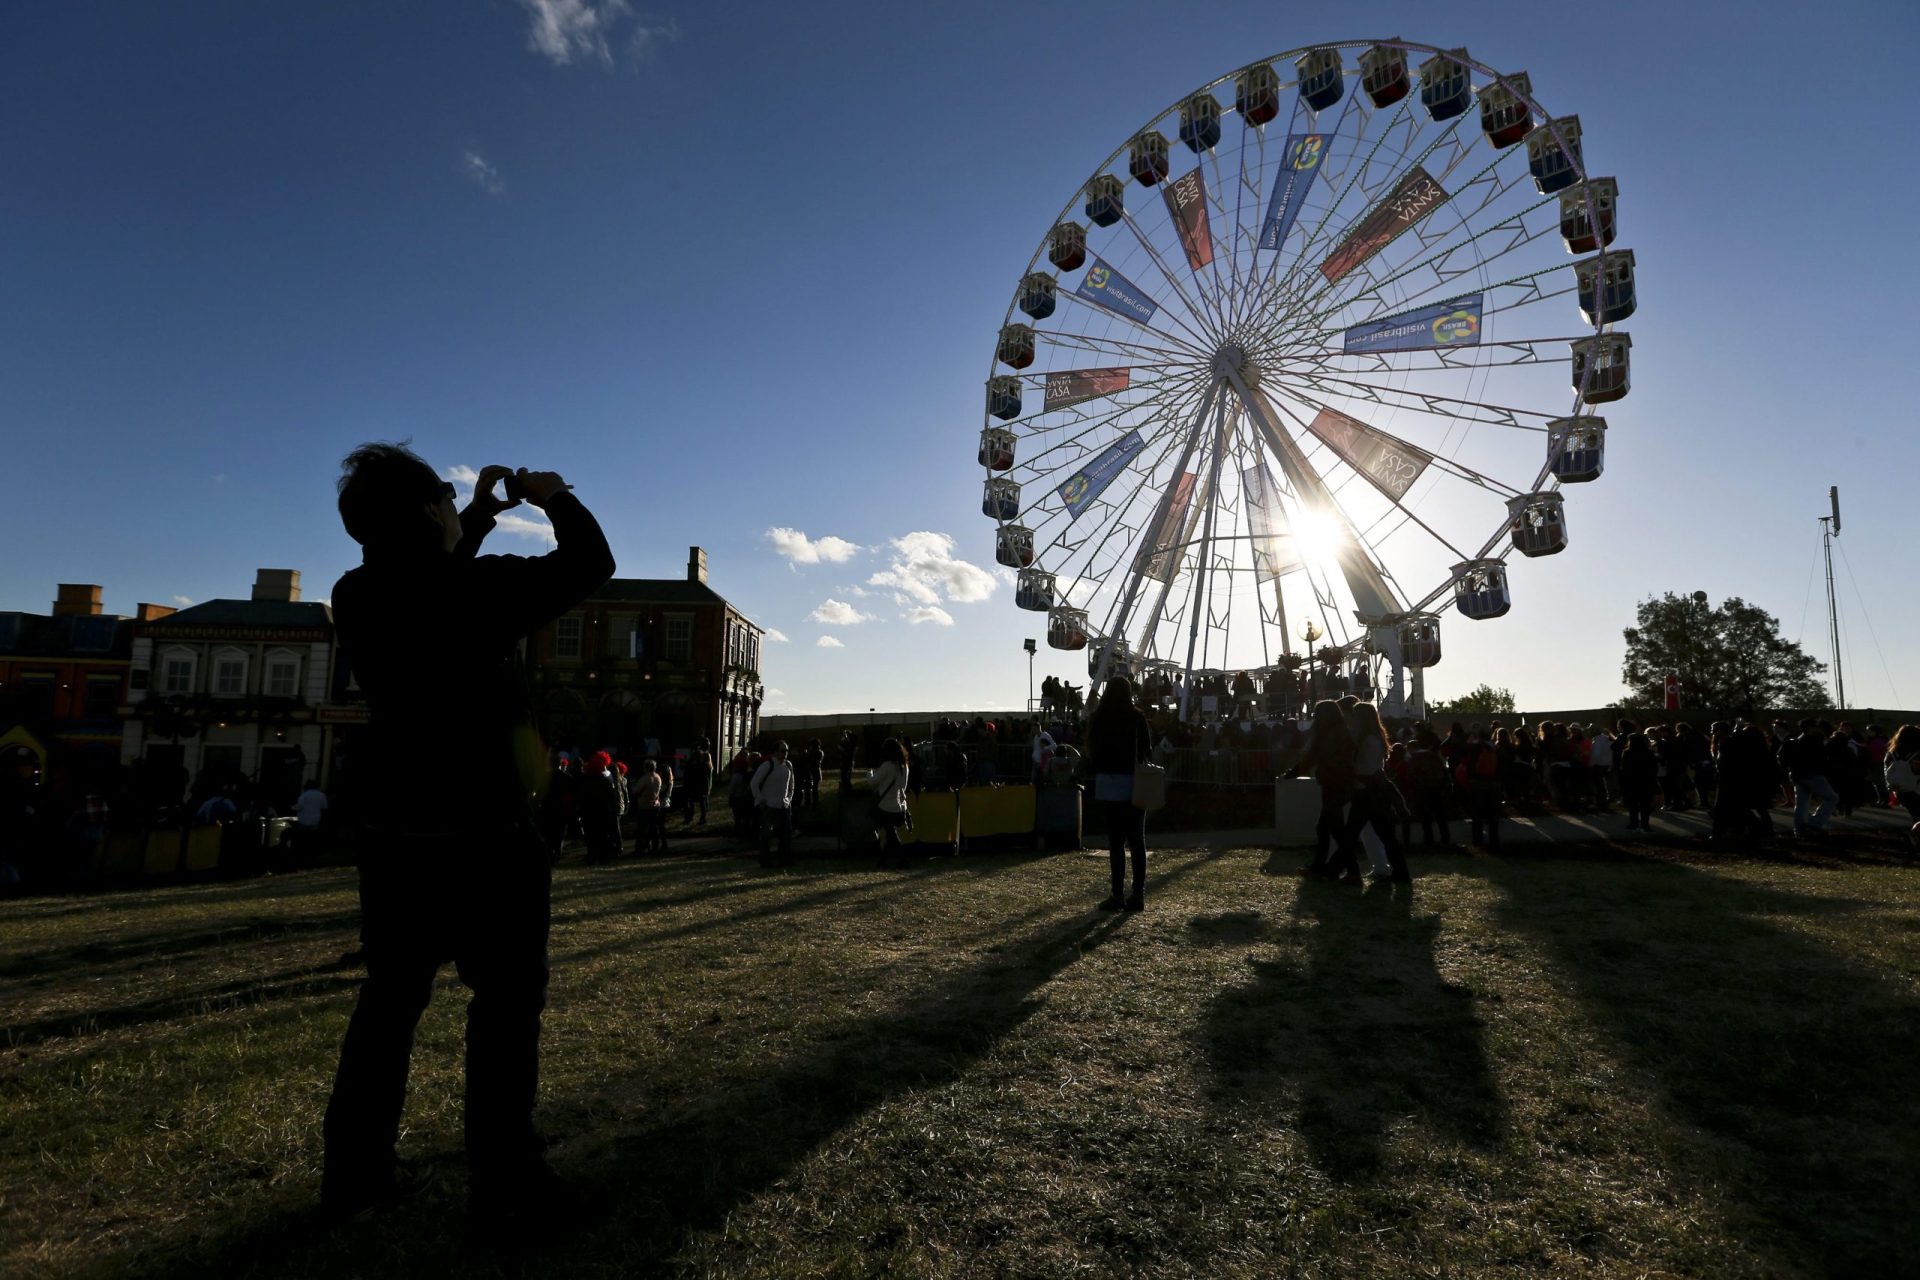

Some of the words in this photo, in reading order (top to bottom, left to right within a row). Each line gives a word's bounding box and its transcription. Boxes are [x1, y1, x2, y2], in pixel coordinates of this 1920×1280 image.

[1174, 179, 1188, 209] CASA
[1185, 172, 1200, 203] SANTA
[1390, 179, 1432, 211] CASA
[1397, 188, 1441, 220] SANTA
[1106, 286, 1152, 317] visitbrasil.com
[1441, 320, 1467, 331] BRASIL
[1047, 384, 1070, 400] CASA
[1369, 461, 1408, 493] SANTA
[1380, 448, 1418, 480] CASA
